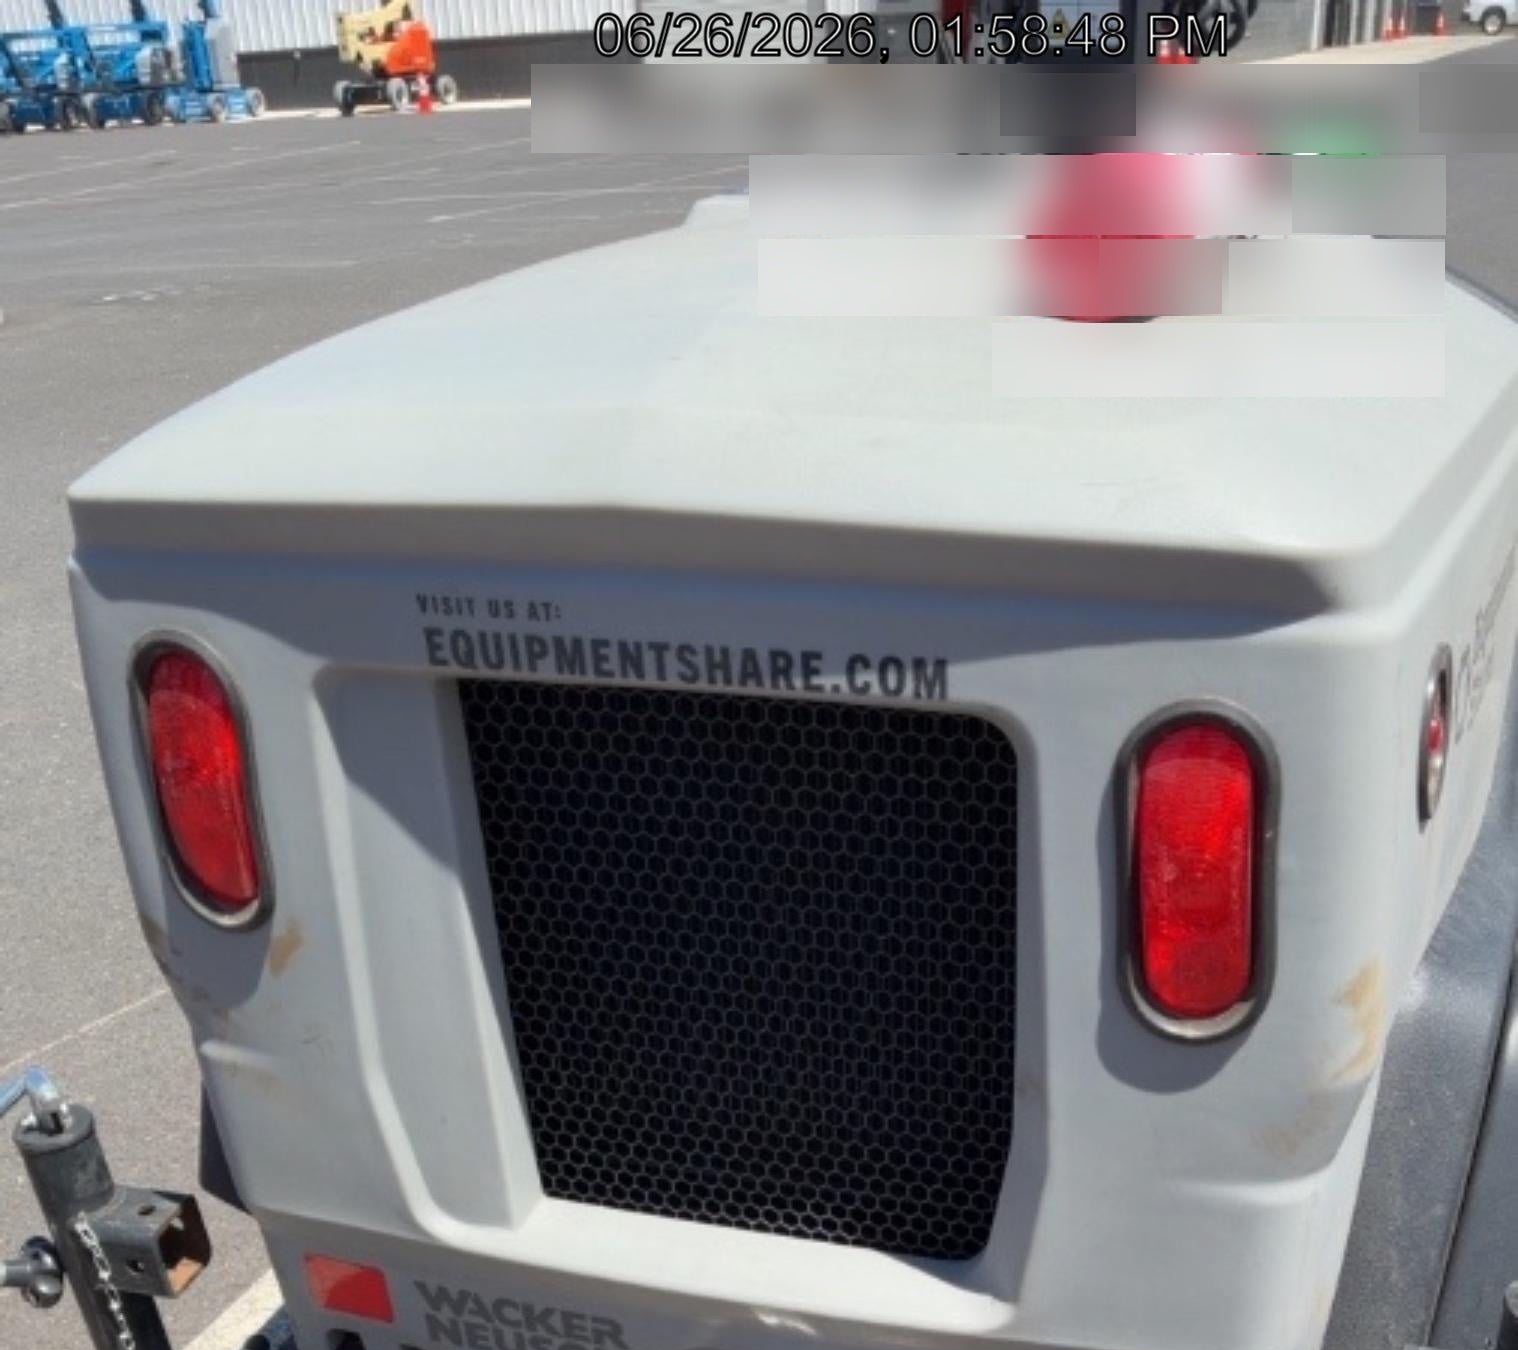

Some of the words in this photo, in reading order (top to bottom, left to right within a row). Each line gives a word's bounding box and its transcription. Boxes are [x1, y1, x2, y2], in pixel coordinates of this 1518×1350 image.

[416, 593, 475, 617] VISIT
[487, 599, 515, 619] US
[528, 601, 561, 621] AT:
[423, 627, 949, 700] EQUIPMENTSHARE.COM
[413, 1279, 632, 1350] WACKER
